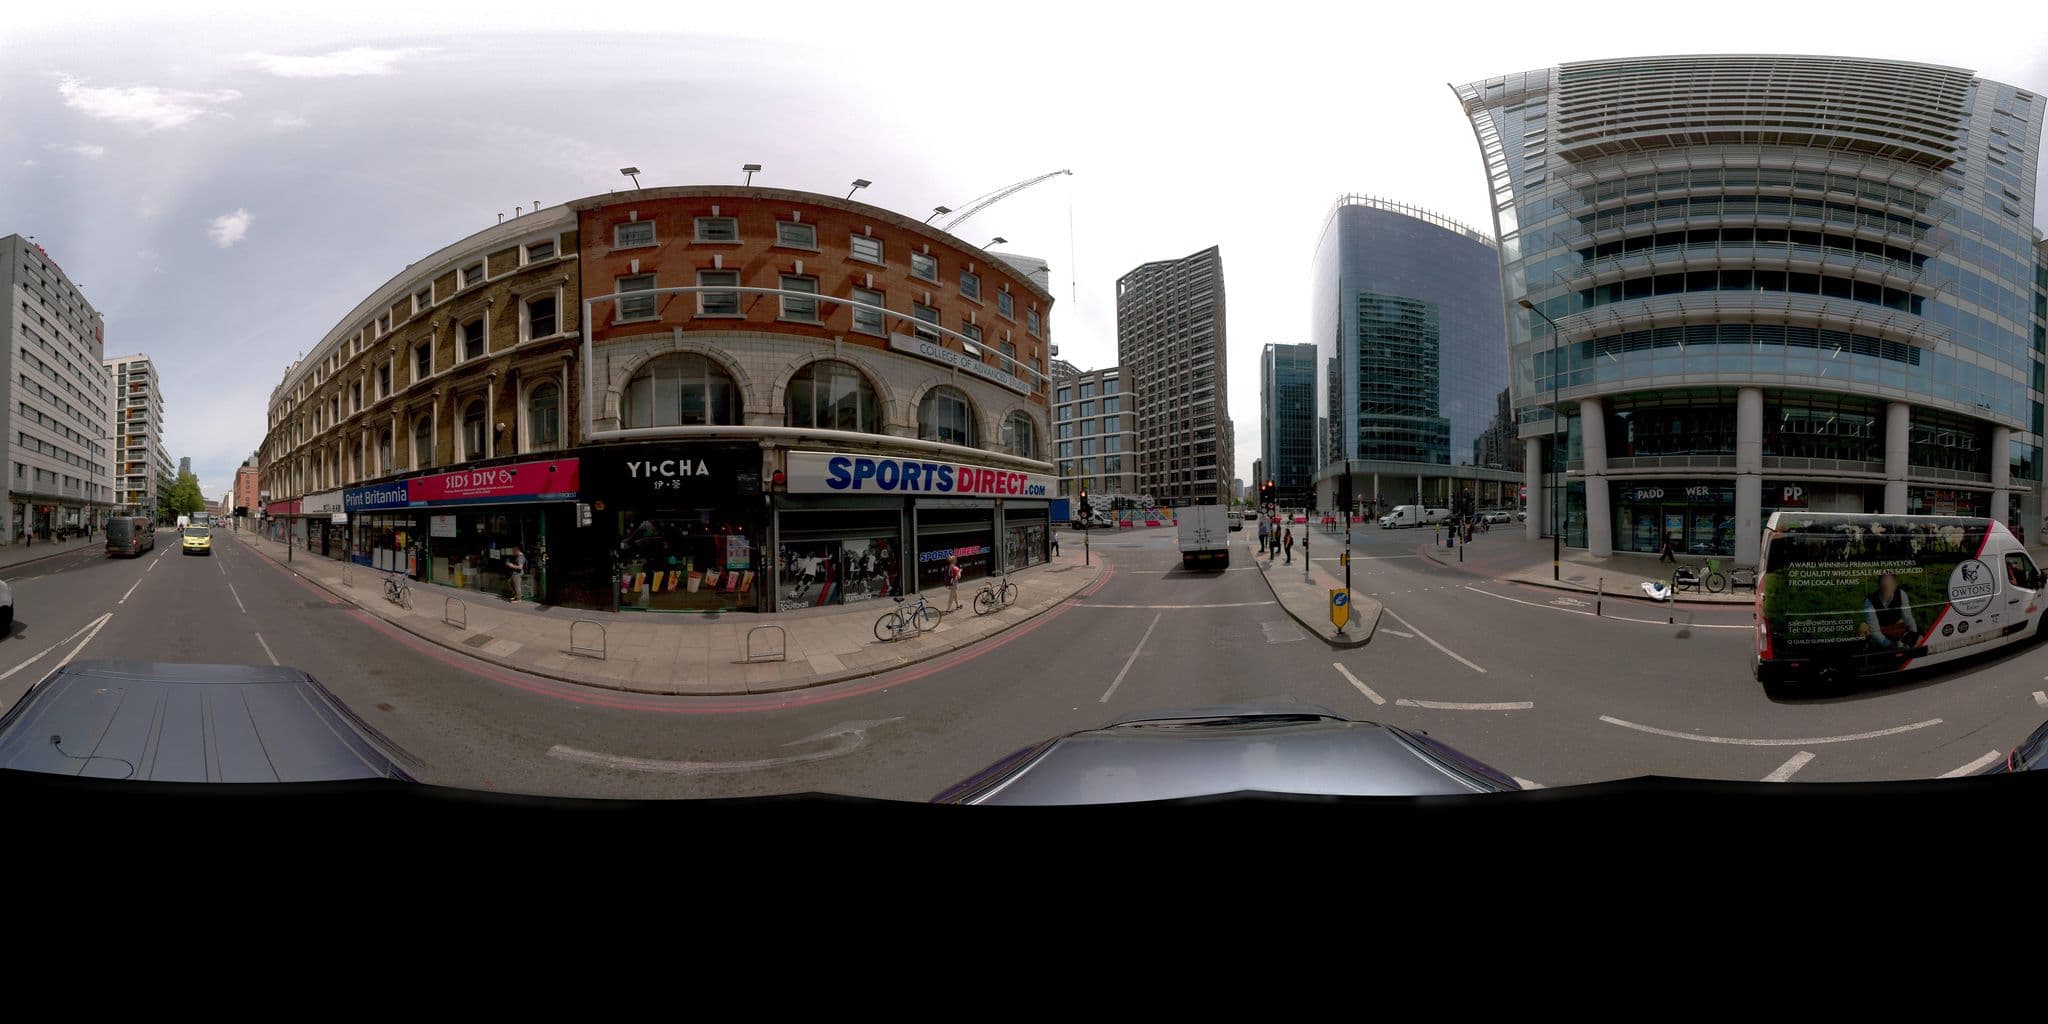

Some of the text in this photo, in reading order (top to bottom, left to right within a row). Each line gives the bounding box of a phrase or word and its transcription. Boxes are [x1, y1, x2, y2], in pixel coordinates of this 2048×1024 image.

[920, 343, 957, 363] COLLEGE
[960, 357, 973, 368] OF
[974, 364, 1007, 382] ADVANCED
[445, 470, 496, 489] SIDS DIY
[345, 486, 407, 506] Print Britannia
[1832, 569, 1872, 577] WHOLESALE
[1895, 567, 1923, 575] SOURCED
